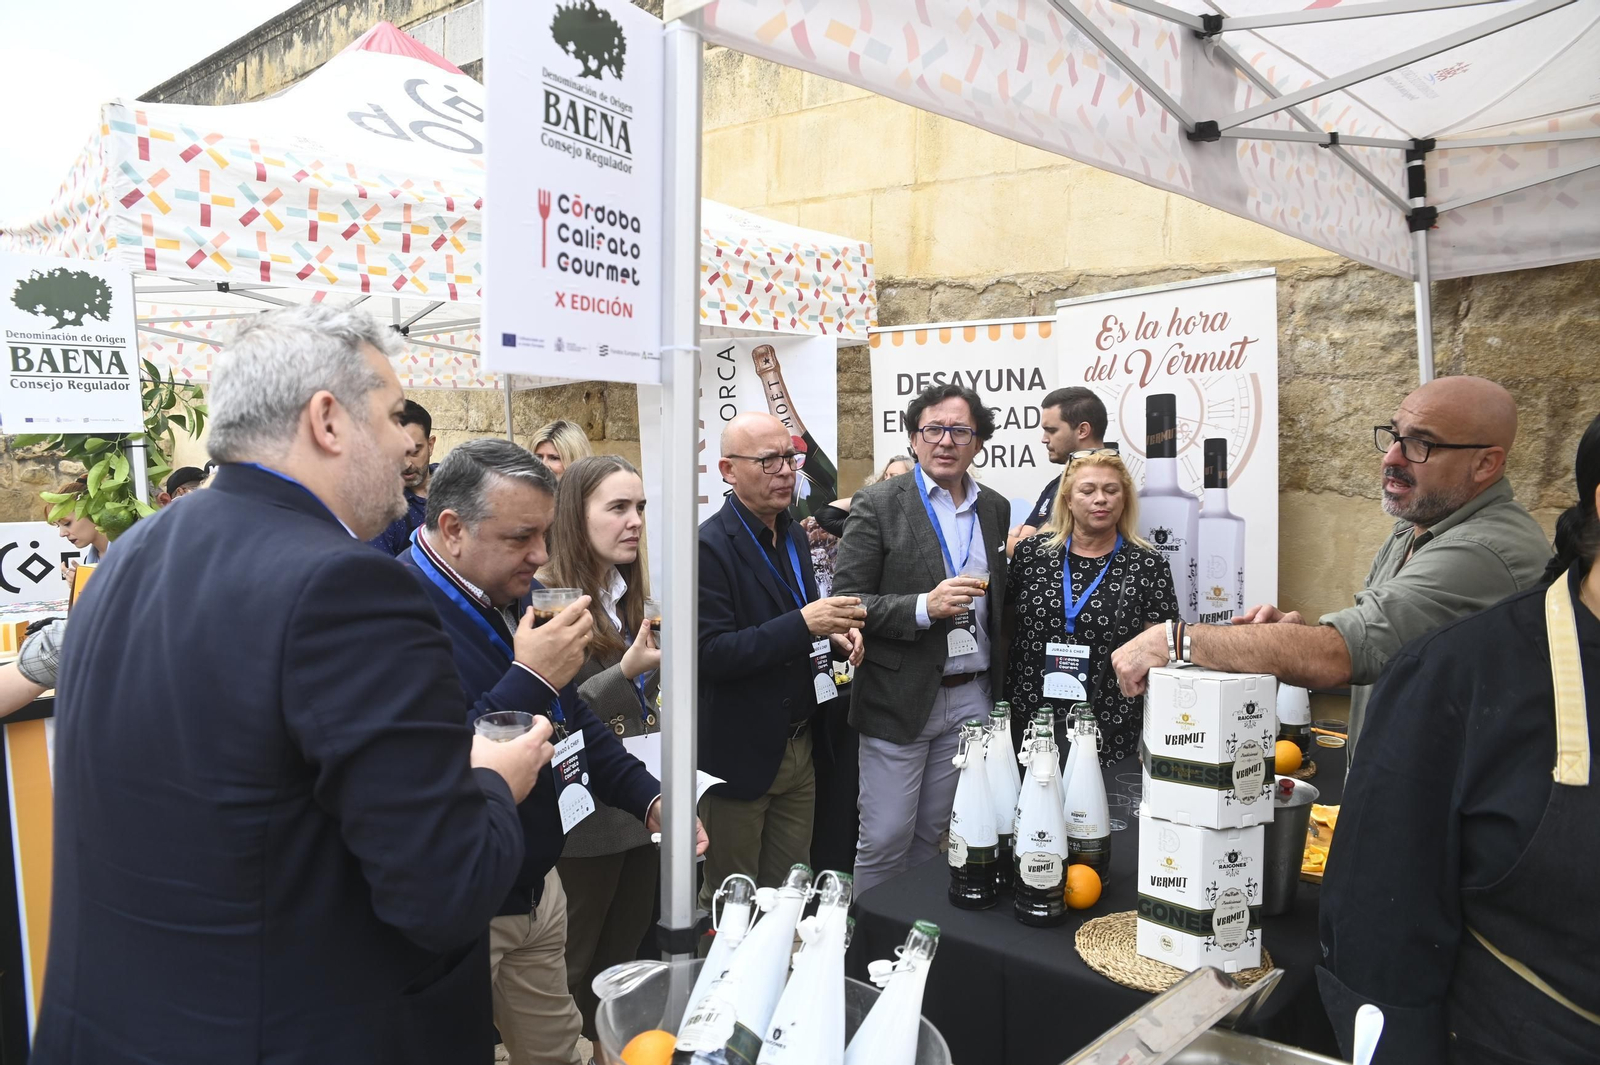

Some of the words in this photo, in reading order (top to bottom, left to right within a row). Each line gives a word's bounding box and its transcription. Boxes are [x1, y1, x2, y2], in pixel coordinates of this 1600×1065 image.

[542, 67, 597, 98] Denominación
[599, 91, 608, 103] de
[610, 95, 632, 113] Origen
[543, 89, 632, 154] BAENA
[540, 133, 582, 159] Consejo
[586, 148, 632, 174] Regulador
[557, 222, 640, 259] Califato
[557, 252, 640, 286] Gourmet
[555, 291, 566, 308] X
[572, 294, 633, 318] EDICIÓN
[6, 330, 78, 342] Denominación
[81, 334, 92, 342] de
[95, 334, 126, 344] Origen
[1096, 314, 1130, 351] Es
[1135, 311, 1162, 341] la
[1166, 306, 1232, 337] hora
[9, 346, 128, 375] BAENA
[1084, 354, 1118, 382] del
[1124, 336, 1259, 388] Vermut
[10, 379, 64, 392] Consejo
[68, 380, 130, 392] Regulador
[1200, 610, 1234, 624] VERMUT
[1165, 732, 1206, 746] VERMUT
[1236, 762, 1262, 780] VERMUT
[1028, 862, 1054, 872] VERMUT
[1150, 875, 1188, 888] VERMUT
[1138, 898, 1211, 933] GONES
[1217, 910, 1245, 926] VERMUT
